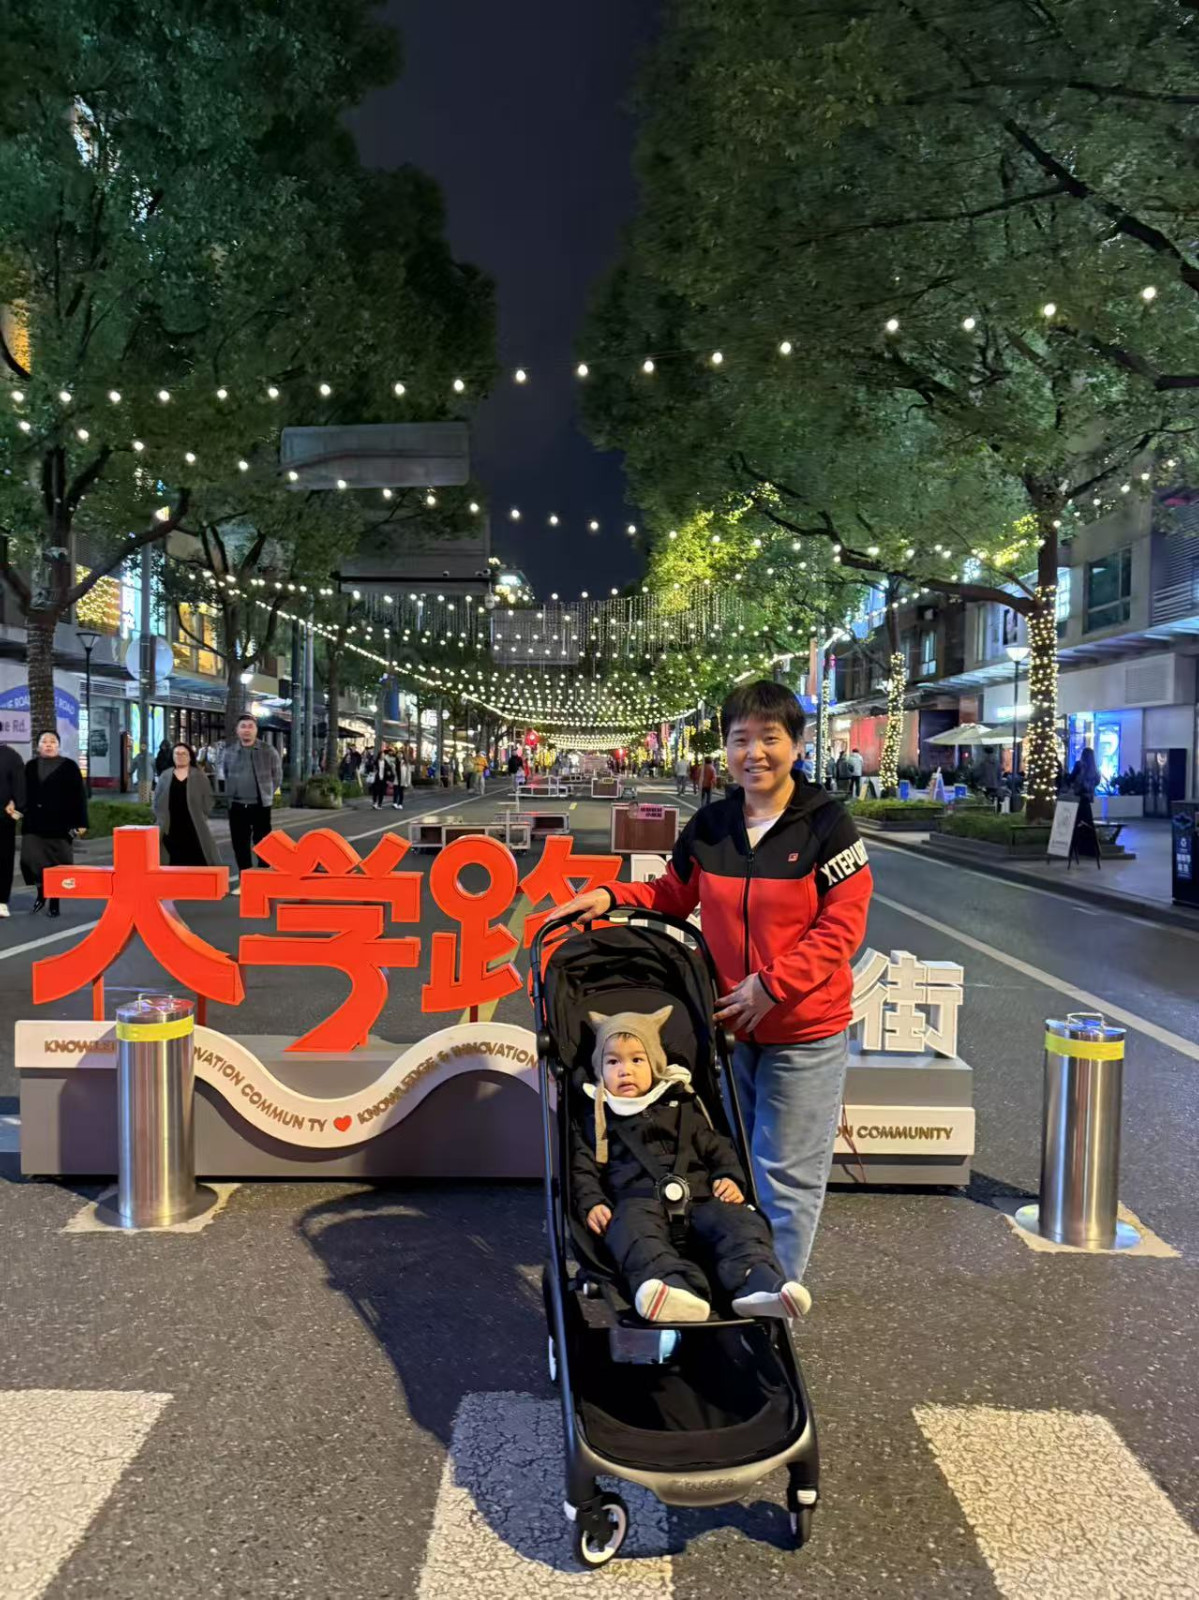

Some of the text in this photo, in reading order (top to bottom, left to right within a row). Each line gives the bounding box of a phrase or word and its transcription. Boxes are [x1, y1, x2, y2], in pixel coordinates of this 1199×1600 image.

[819, 837, 869, 886] XTEPU
[32, 825, 623, 1051] 大学路
[356, 1056, 437, 1125] KNOWLEDGE
[856, 1125, 953, 1140] COMMUNITY
